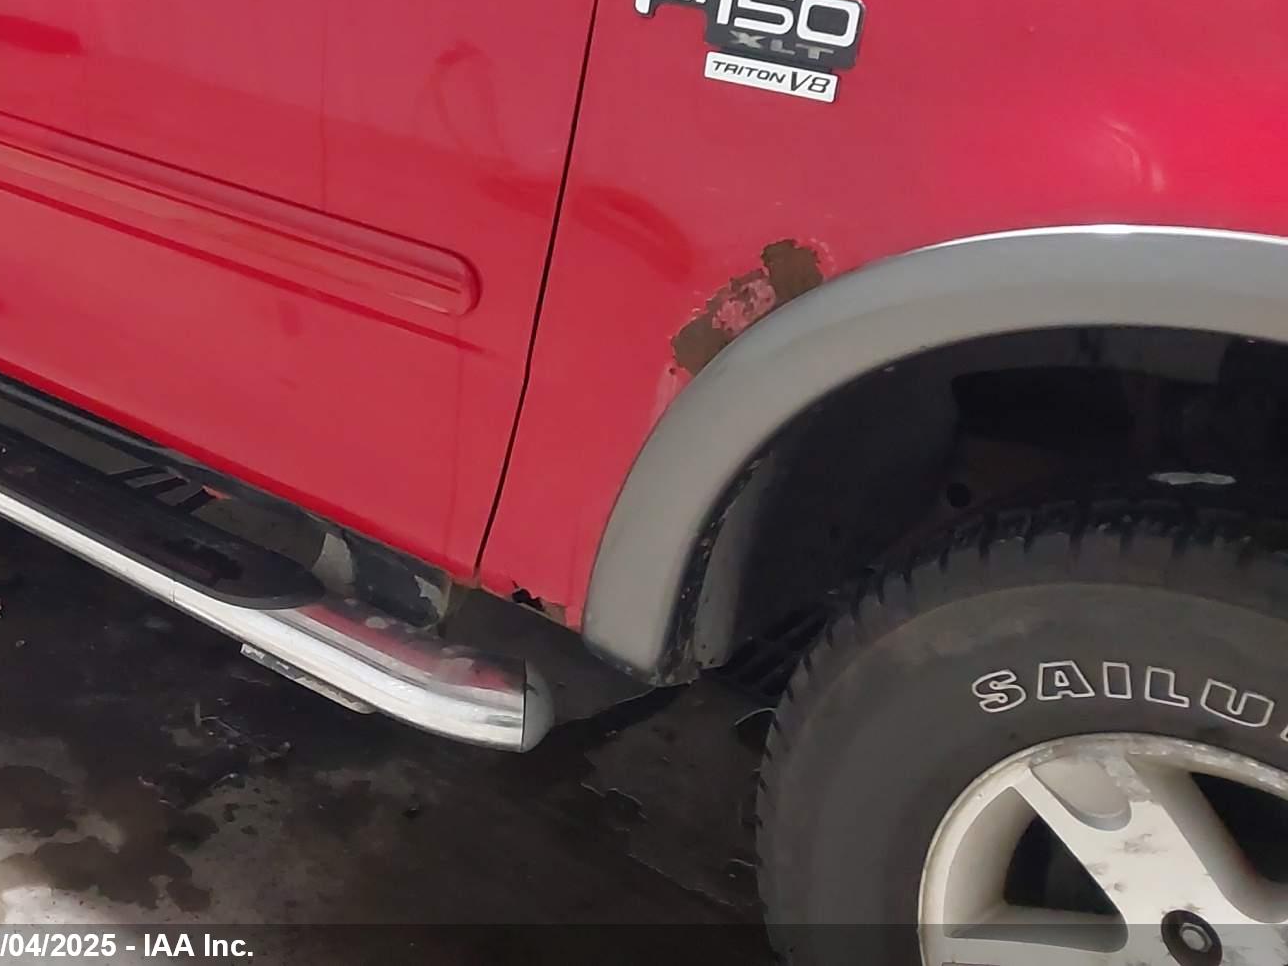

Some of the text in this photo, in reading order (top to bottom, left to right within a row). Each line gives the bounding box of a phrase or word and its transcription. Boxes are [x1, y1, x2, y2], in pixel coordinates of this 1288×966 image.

[730, 30, 834, 60] XLT
[712, 59, 831, 94] TRITON V8
[971, 660, 1288, 742] SAILU
